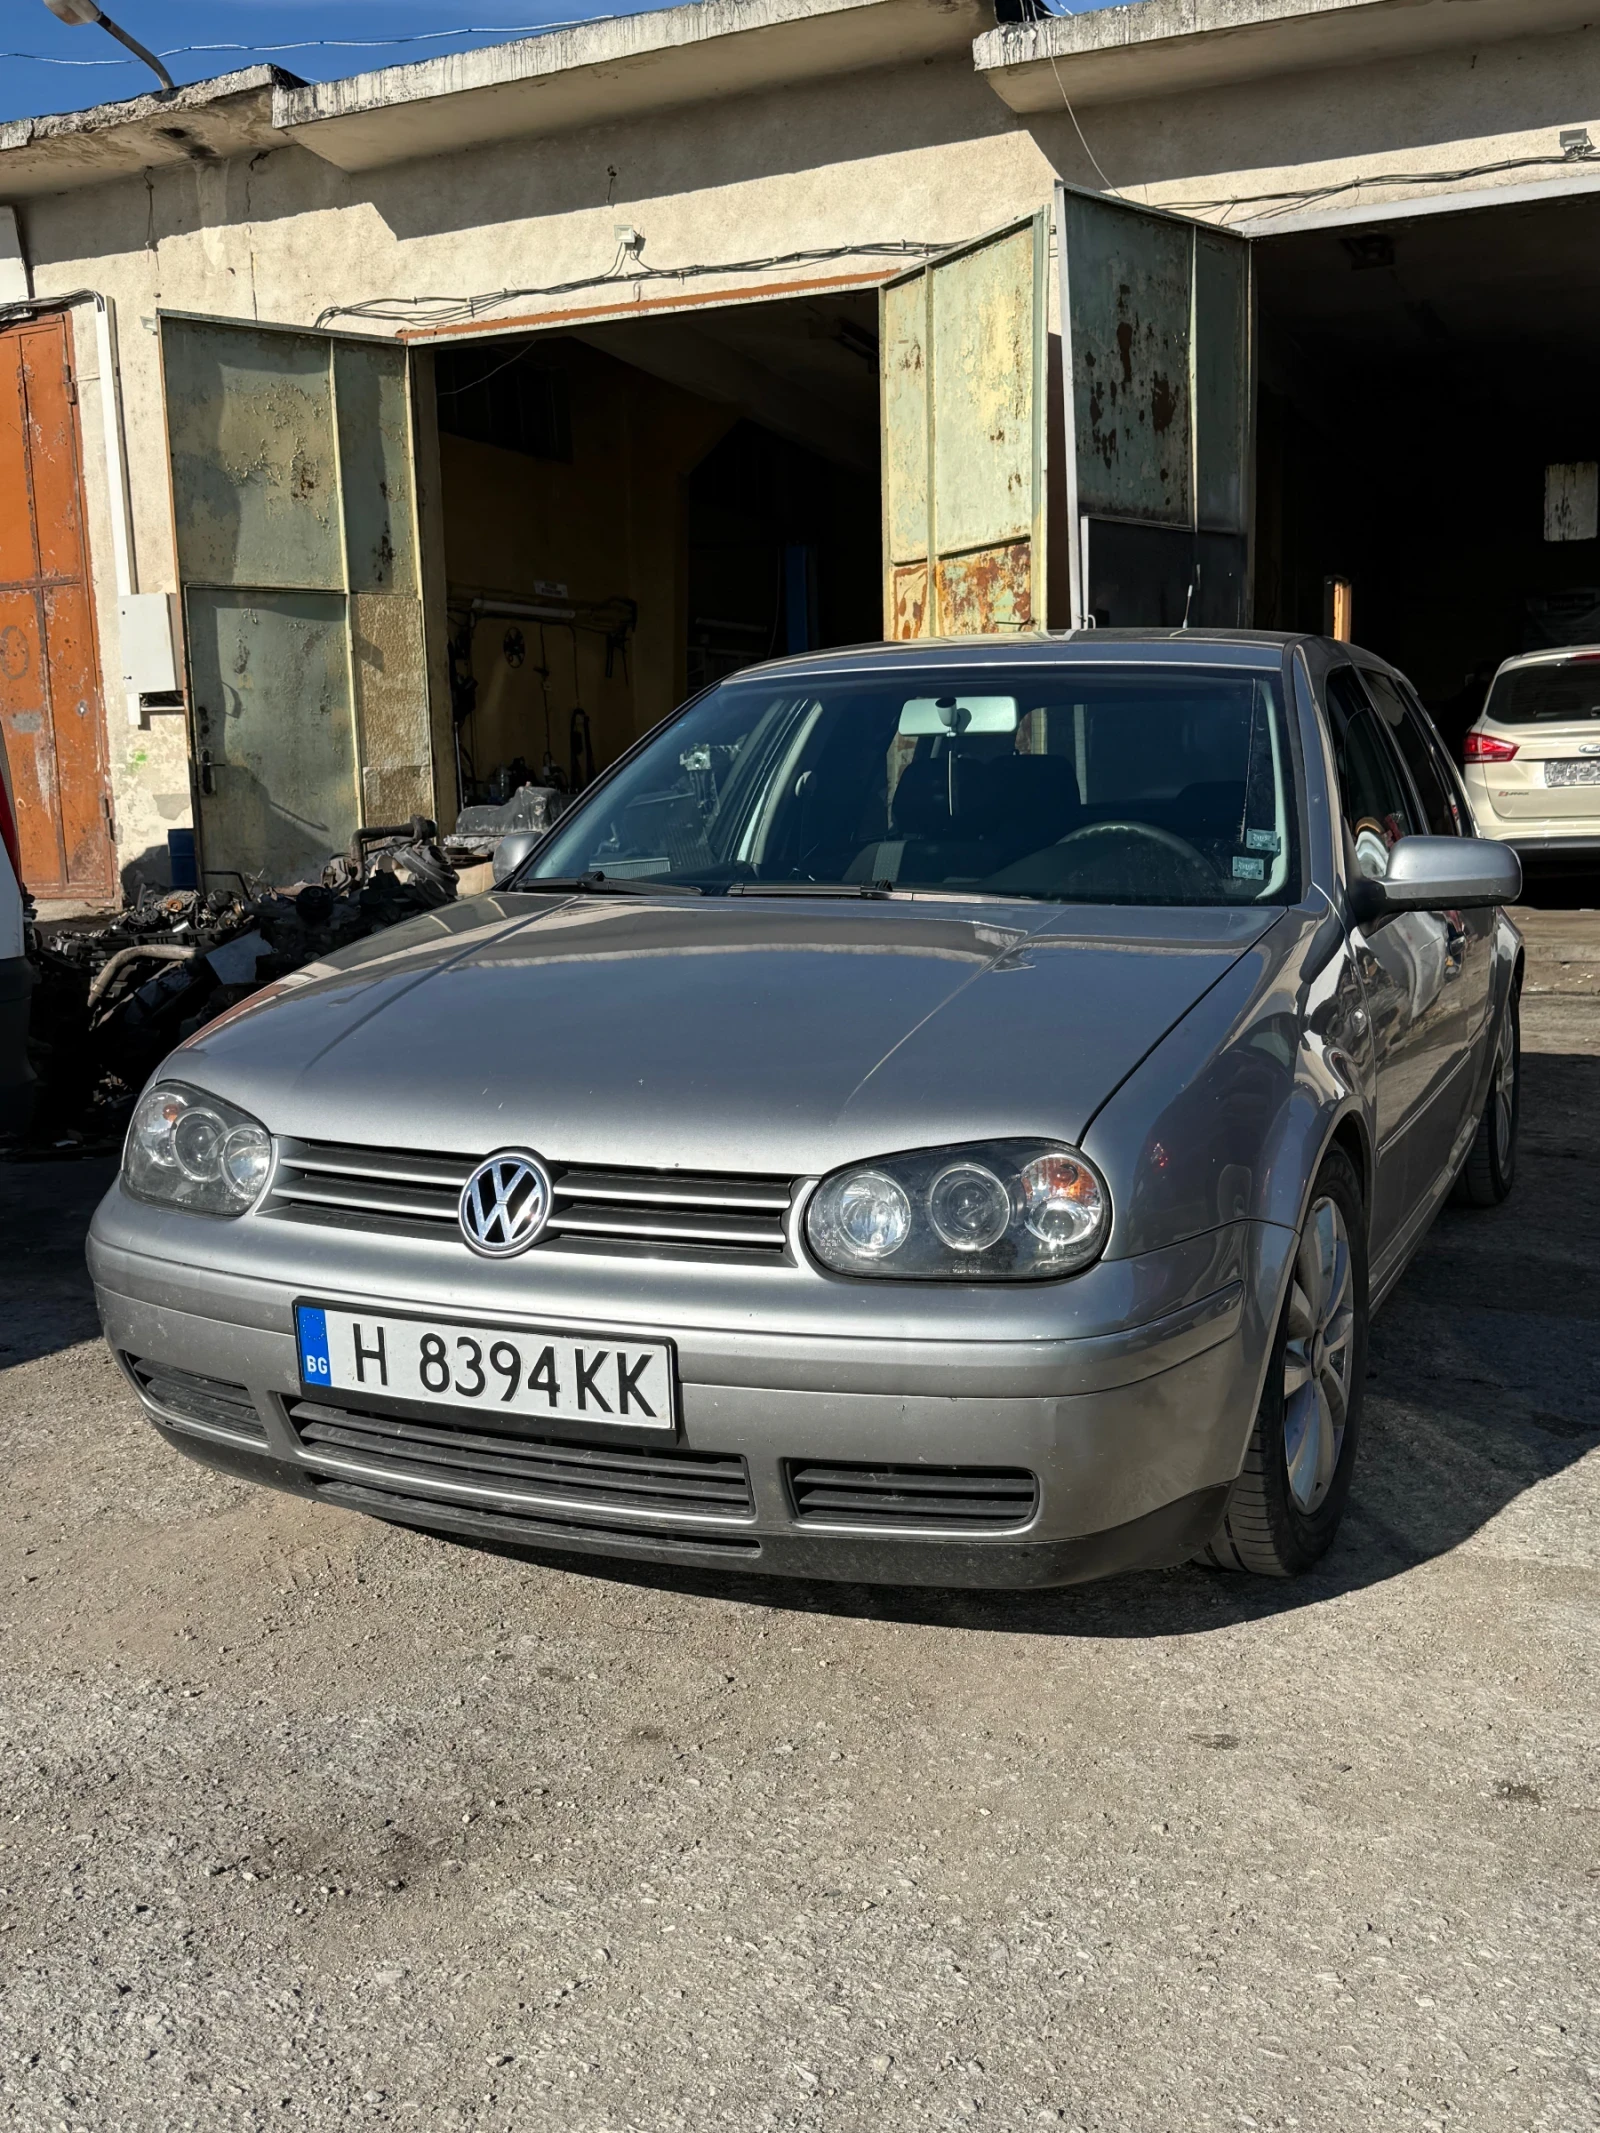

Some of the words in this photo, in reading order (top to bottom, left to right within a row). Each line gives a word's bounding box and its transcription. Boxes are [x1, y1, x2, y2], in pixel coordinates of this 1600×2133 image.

[466, 1161, 544, 1247] VW
[306, 1354, 328, 1375] BG
[352, 1323, 388, 1386] H
[419, 1332, 657, 1418] 8394KK
